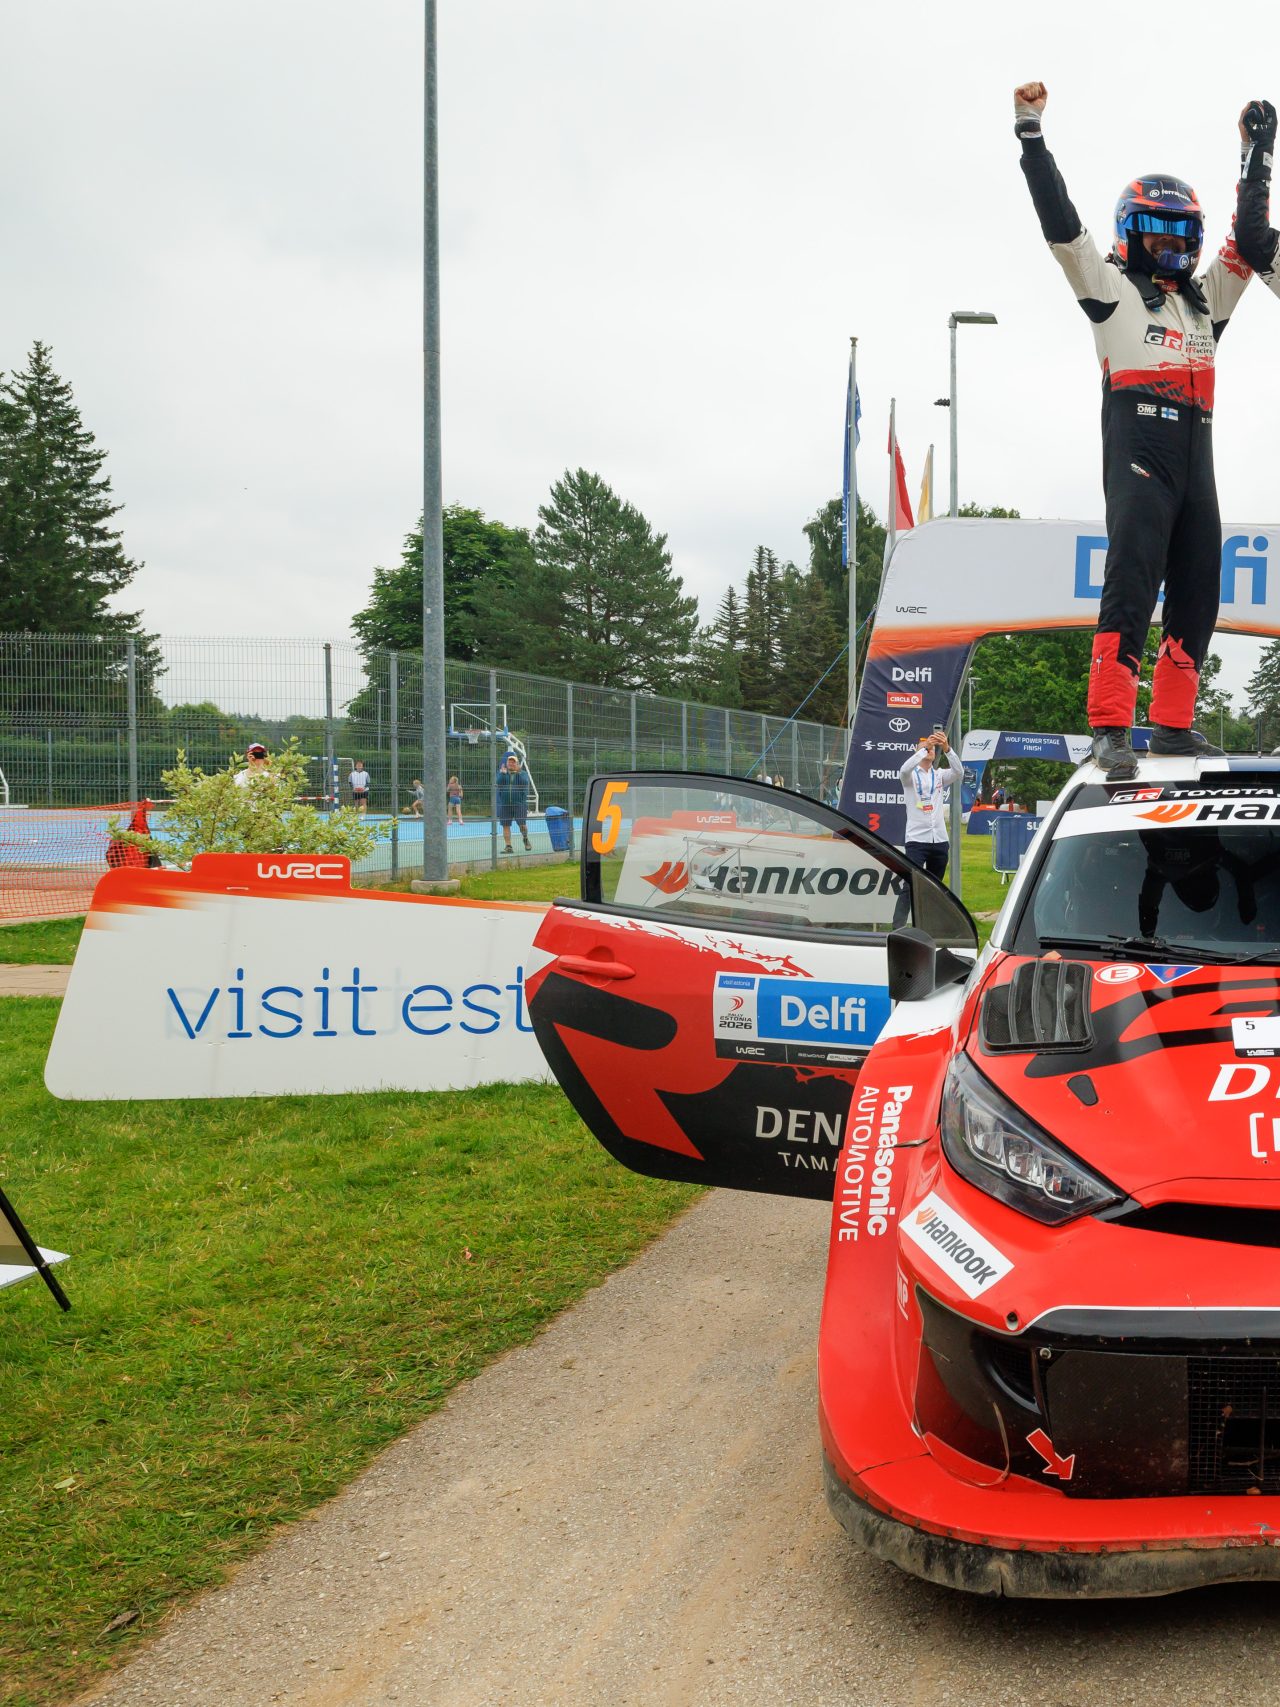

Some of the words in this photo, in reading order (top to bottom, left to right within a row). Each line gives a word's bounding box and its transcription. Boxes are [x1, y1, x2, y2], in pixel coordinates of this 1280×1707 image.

[1145, 329, 1183, 350] GR
[1137, 405, 1157, 414] OMP
[1074, 535, 1269, 605] Dfi
[896, 606, 927, 614] WRC
[892, 667, 932, 682] Delfi
[911, 696, 919, 704] K
[870, 769, 900, 779] FORU
[1112, 789, 1161, 802] GR
[1169, 788, 1275, 798] TOYOTA
[592, 781, 629, 855] 5
[696, 815, 733, 825] WRC
[257, 862, 344, 880] WRC
[1110, 968, 1129, 980] E
[166, 966, 378, 1039] visit
[401, 965, 534, 1036] est
[780, 995, 866, 1033] Delfi
[719, 1020, 753, 1030] 2026
[1245, 1020, 1256, 1030] 5
[736, 1046, 765, 1056] WRC
[755, 1105, 842, 1146] DEN
[838, 1086, 880, 1242] AUTOMOTIVE
[867, 1085, 913, 1236] Panasonic
